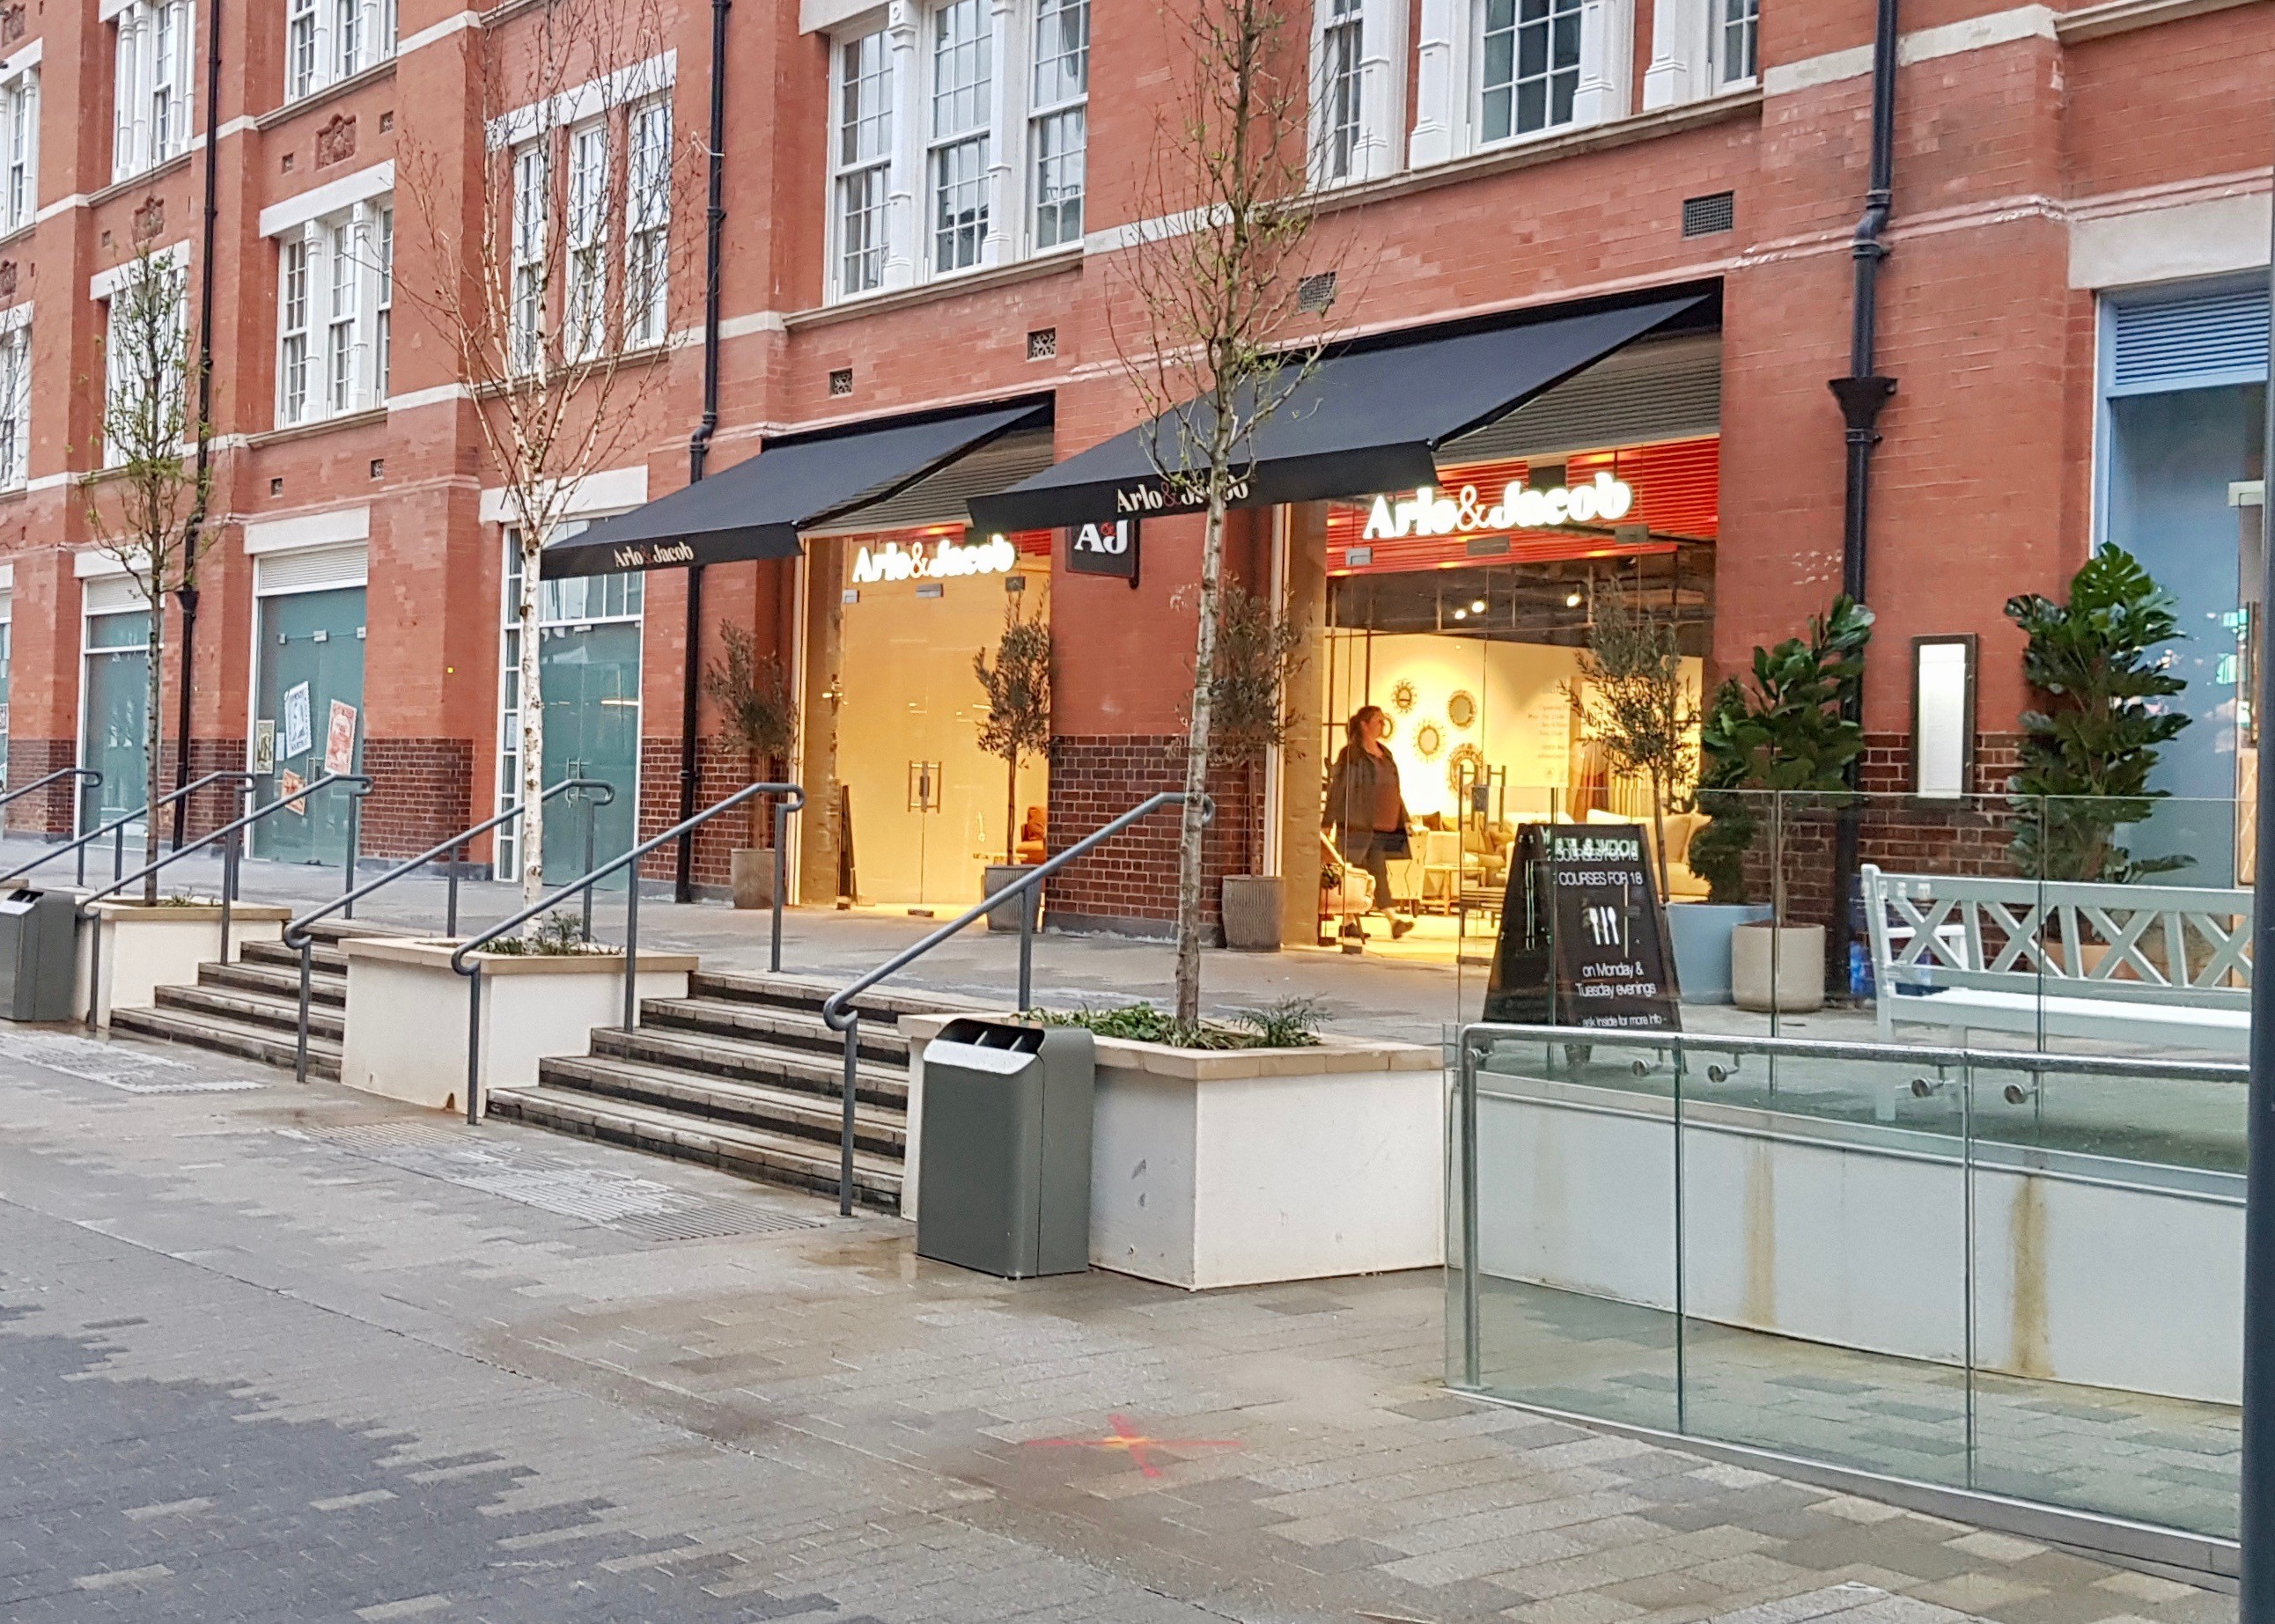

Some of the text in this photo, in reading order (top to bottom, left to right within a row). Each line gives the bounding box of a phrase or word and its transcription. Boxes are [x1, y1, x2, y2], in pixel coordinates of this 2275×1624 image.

[1558, 871, 1607, 885] COURSES
[1607, 871, 1629, 885] FOR
[1582, 960, 1645, 979] on Monday &
[1575, 981, 1656, 999] Tuesday evenings
